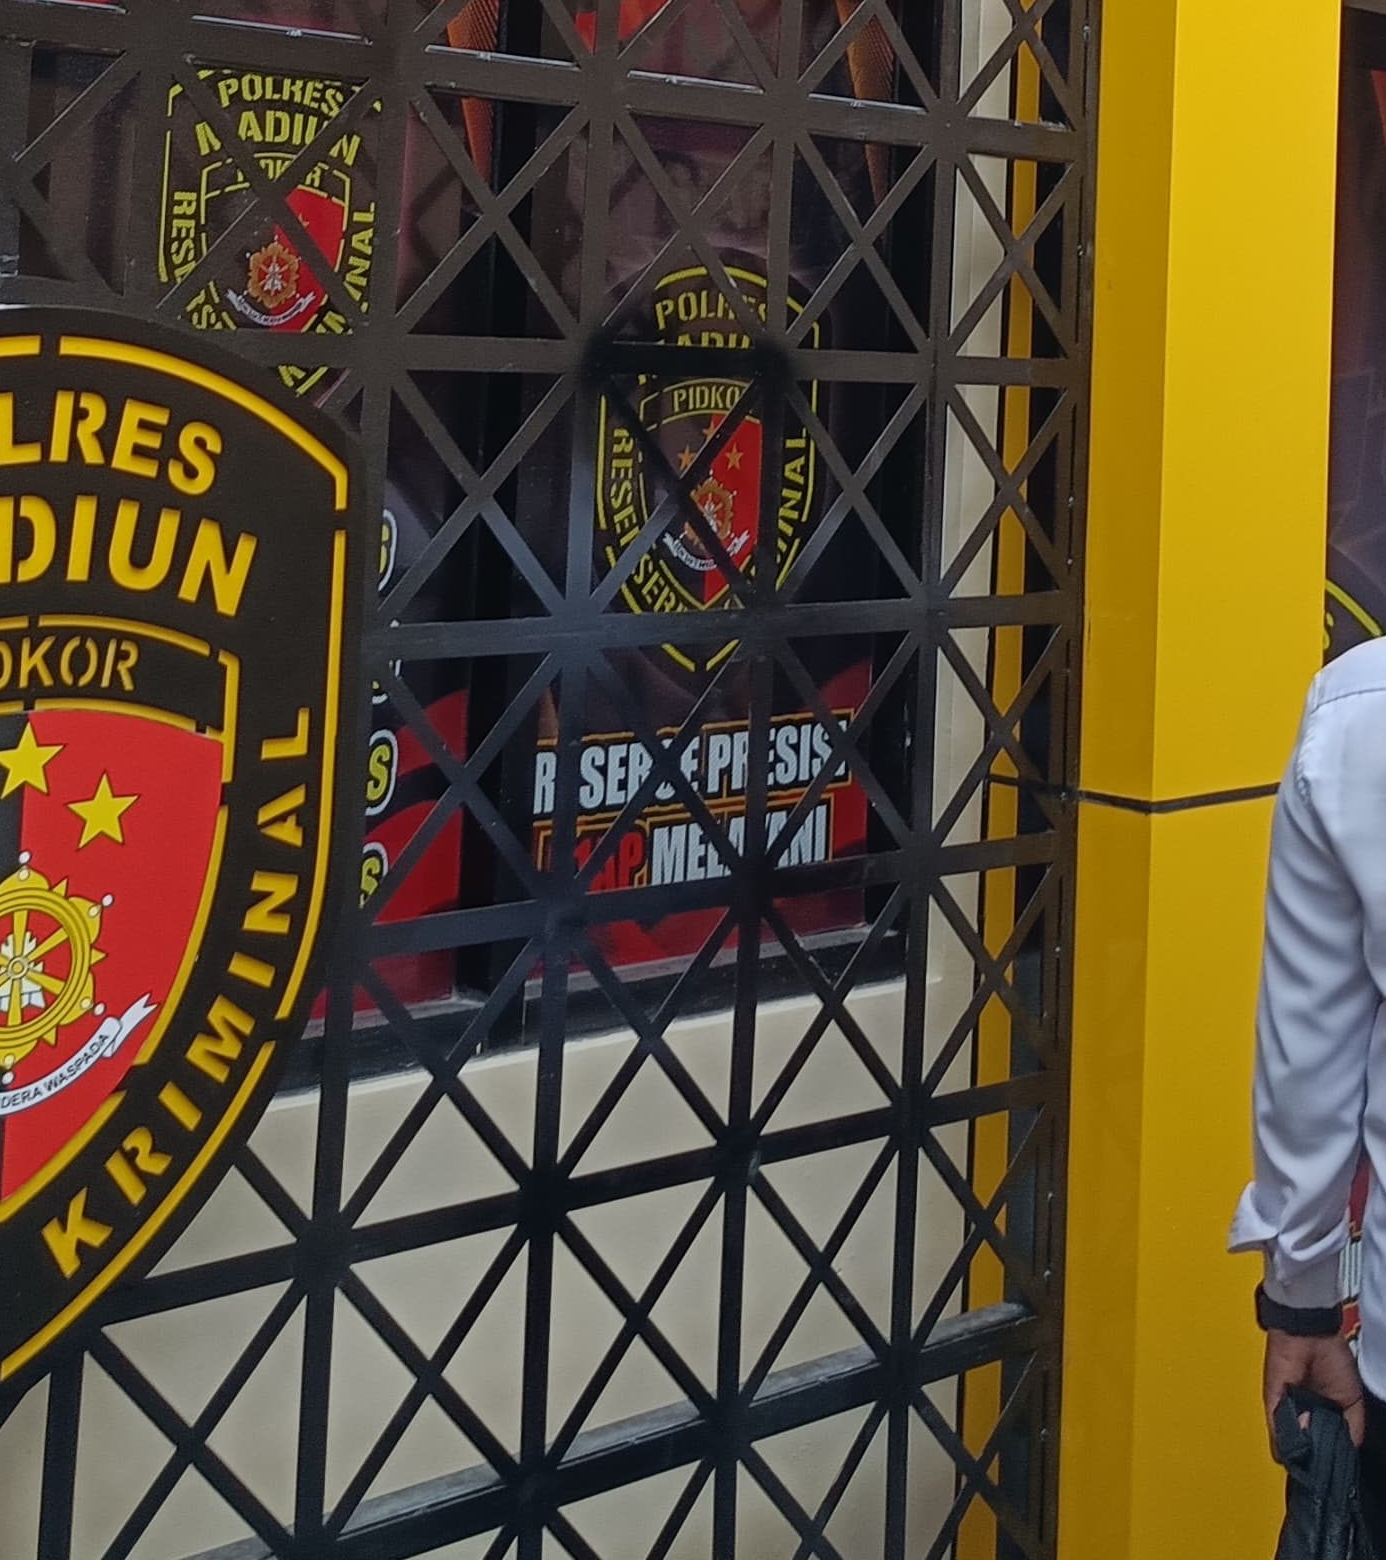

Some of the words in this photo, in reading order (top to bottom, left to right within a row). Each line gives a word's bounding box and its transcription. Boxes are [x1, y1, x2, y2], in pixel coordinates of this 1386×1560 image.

[673, 383, 744, 413] PIDKO
[40, 706, 312, 1282] KRIMINAL
[42, 1033, 109, 1092] WASPADA
